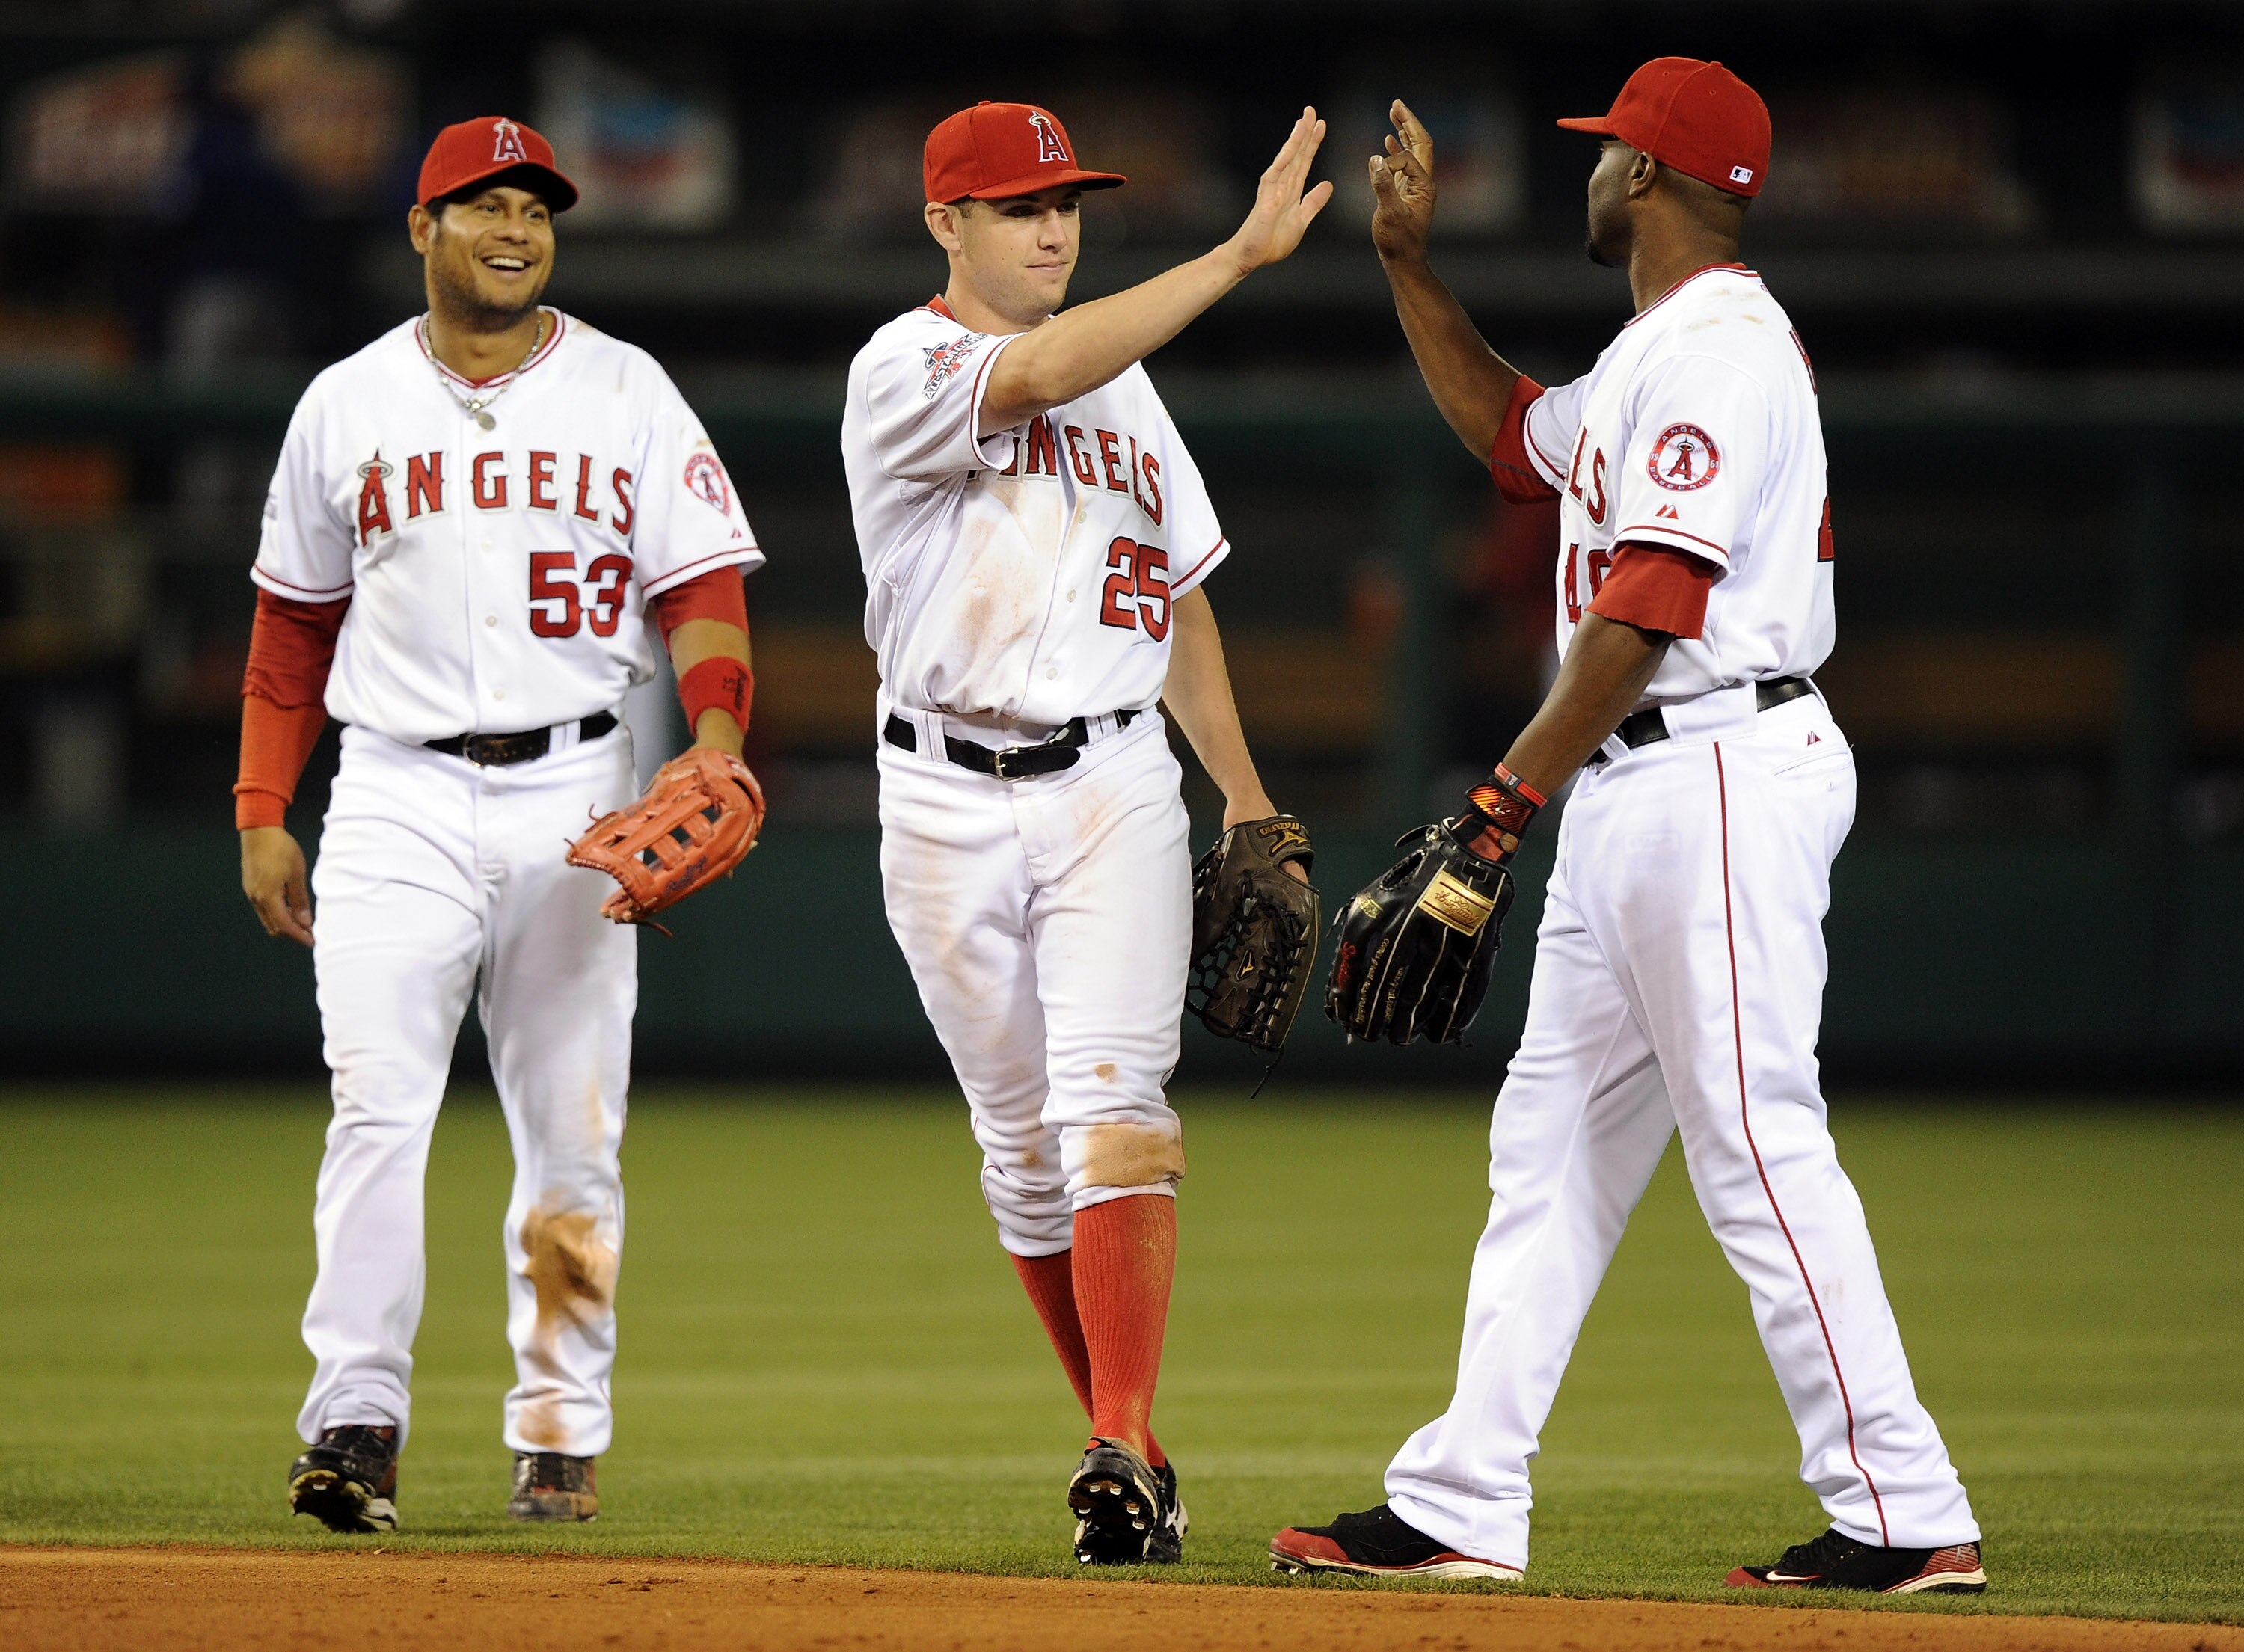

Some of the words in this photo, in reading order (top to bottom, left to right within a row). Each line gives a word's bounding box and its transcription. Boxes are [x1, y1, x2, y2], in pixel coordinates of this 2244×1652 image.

[492, 118, 527, 162] A
[1029, 111, 1069, 162] A
[1661, 426, 1714, 449] ANGELS
[1666, 436, 1694, 481] A
[1649, 466, 1714, 491] BASEBALL
[1710, 459, 1719, 469] 61
[356, 447, 637, 548] ANGELS
[528, 550, 634, 639] 53
[1100, 535, 1172, 643] 25
[1435, 890, 1480, 924] Rawlings
